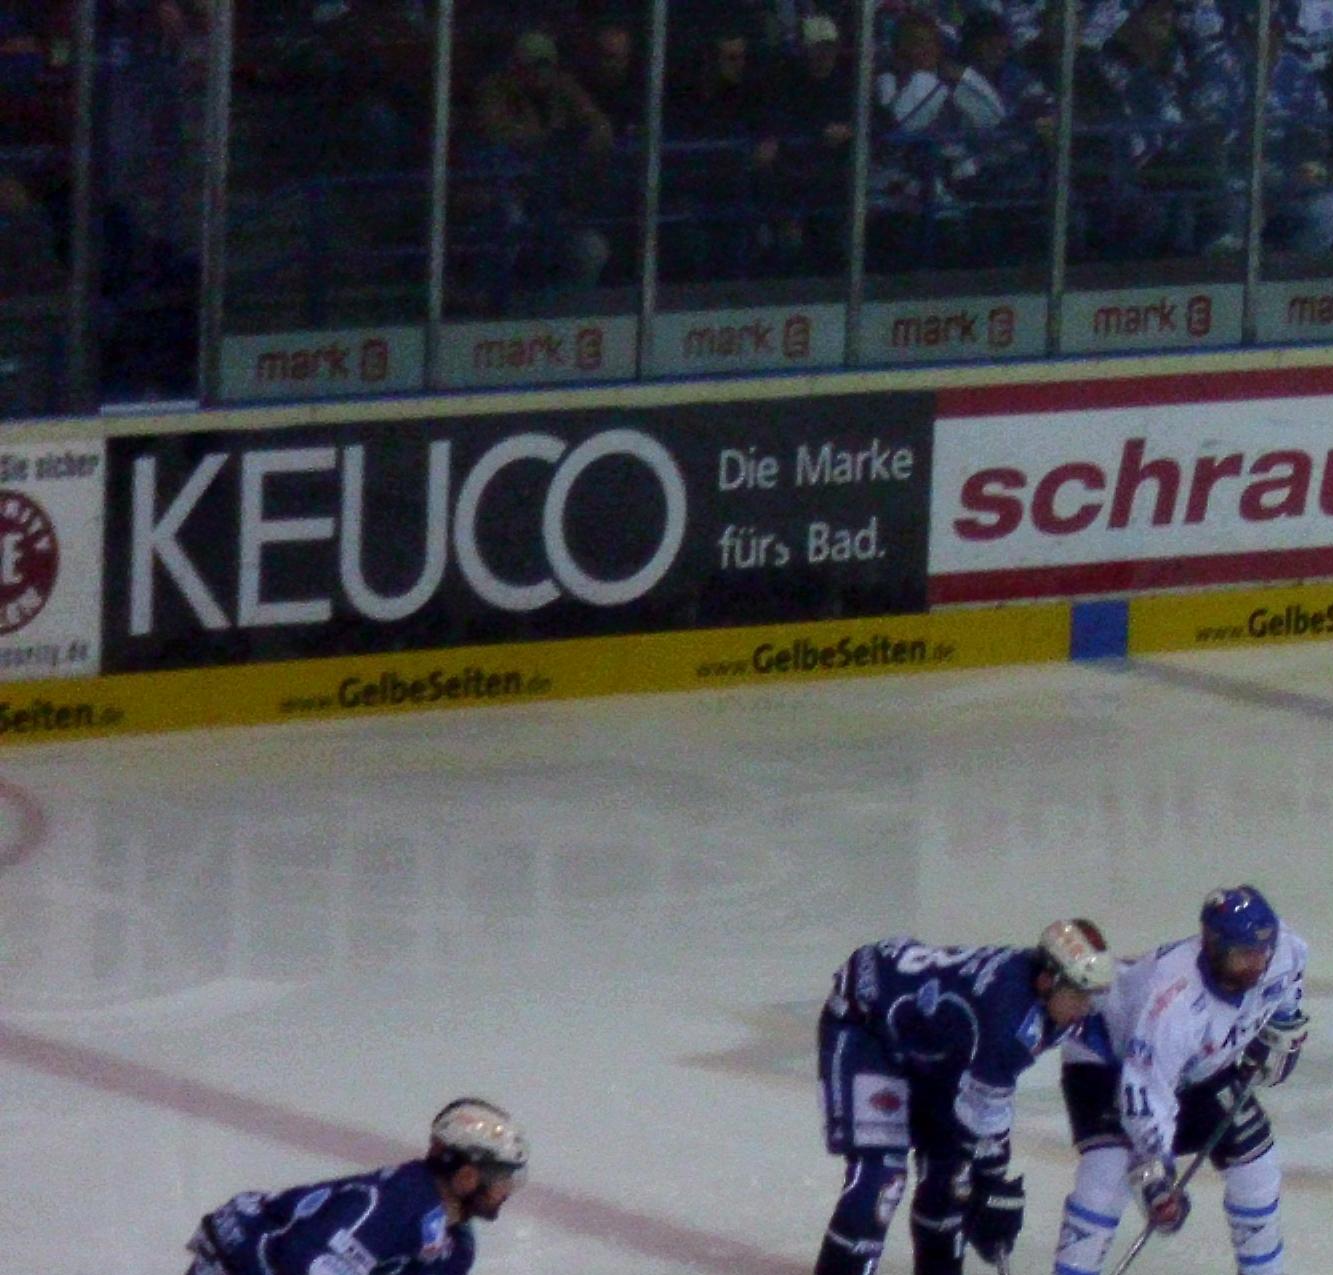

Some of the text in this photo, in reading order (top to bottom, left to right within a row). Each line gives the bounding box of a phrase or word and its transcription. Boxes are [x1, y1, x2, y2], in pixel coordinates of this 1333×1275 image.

[892, 311, 976, 346] mark
[1093, 299, 1176, 337] mark
[474, 336, 562, 367] mark
[682, 320, 773, 358] mark
[257, 344, 348, 380] mark
[719, 440, 914, 492] Die Marke
[128, 428, 686, 637] KEUCO
[716, 515, 886, 570] fürs Bad.
